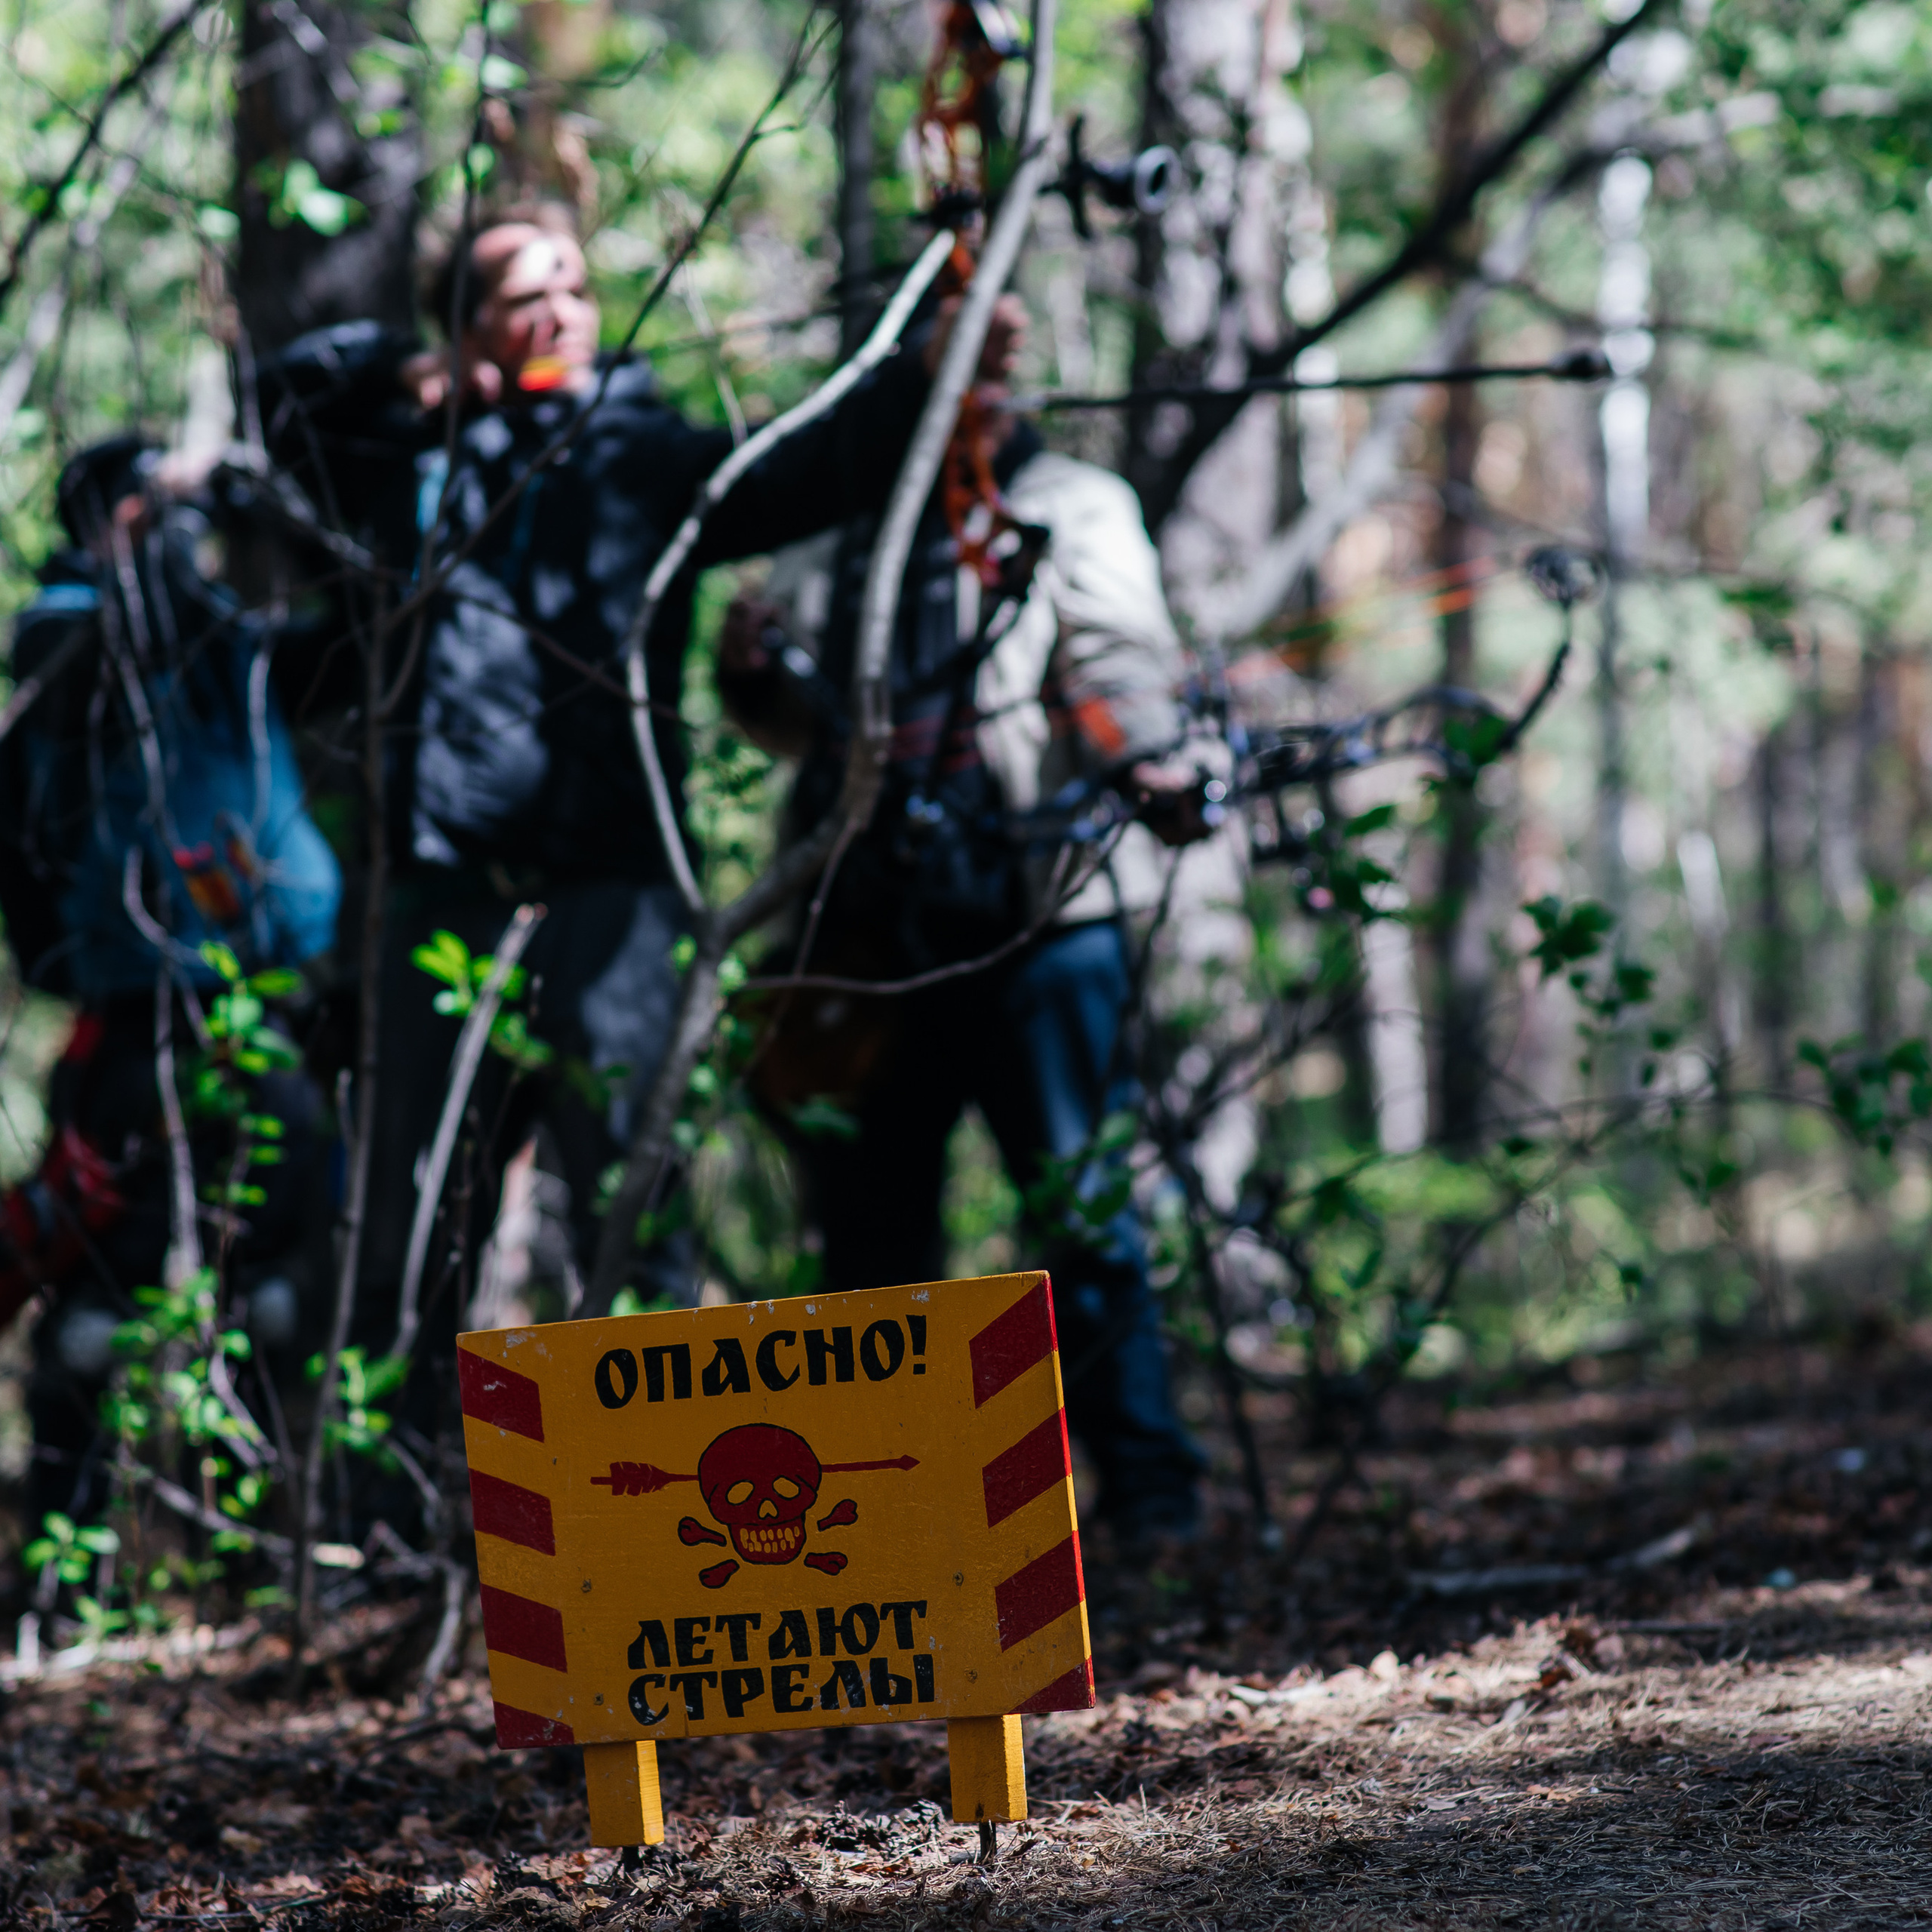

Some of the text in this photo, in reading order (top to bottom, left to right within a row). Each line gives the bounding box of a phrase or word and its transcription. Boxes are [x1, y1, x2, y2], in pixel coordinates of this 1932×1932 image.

[594, 1314, 928, 1410] ОПАСНО!
[627, 1600, 928, 1670] ЛЕТАЮТ
[628, 1654, 935, 1727] СТРЕЛЫ
